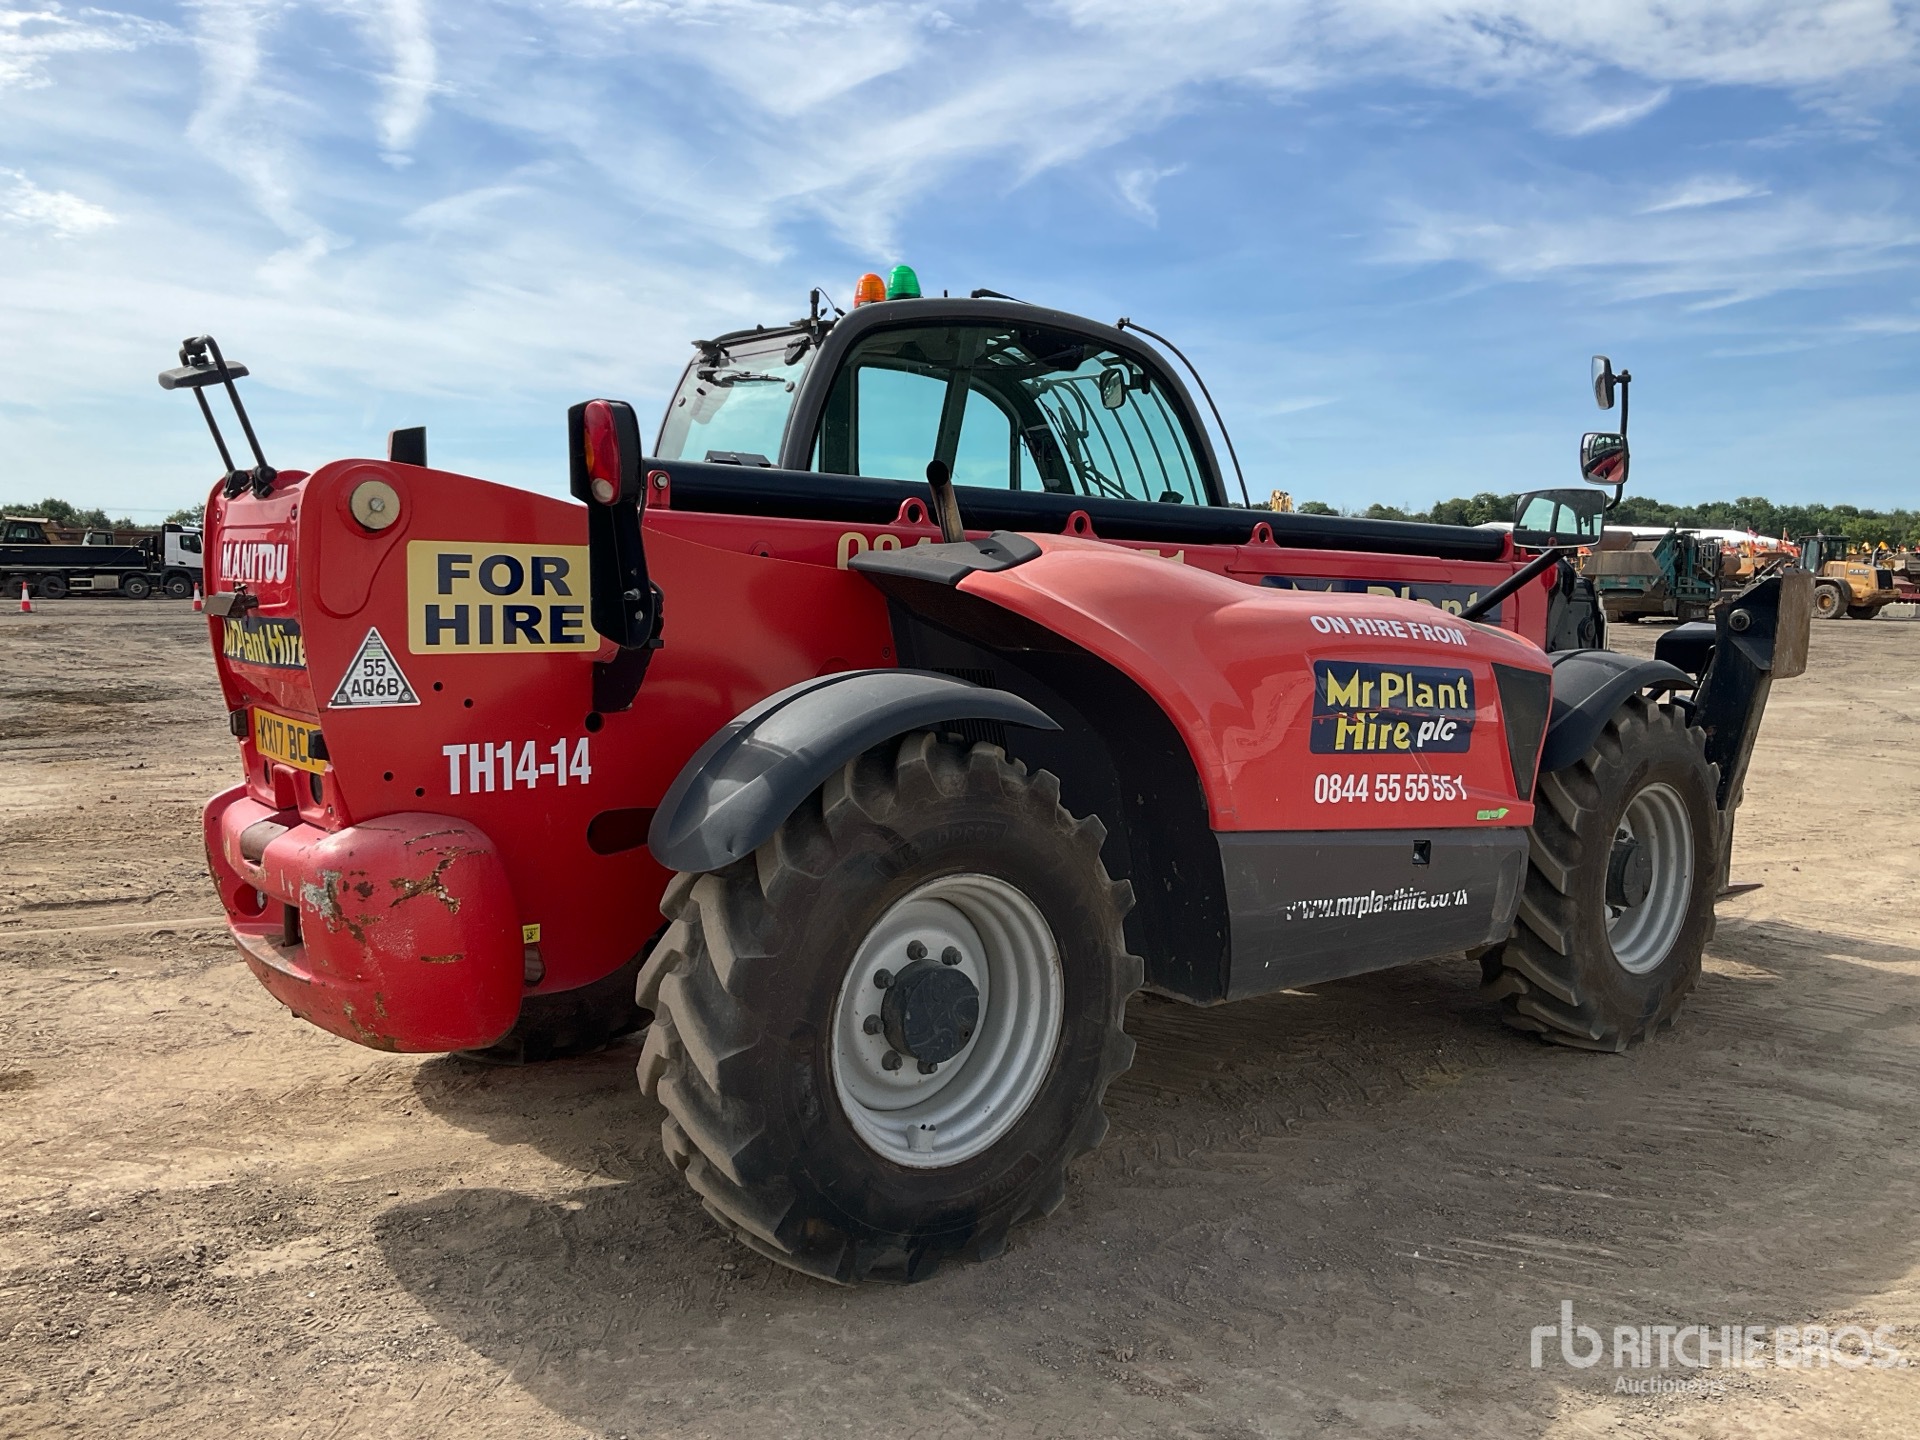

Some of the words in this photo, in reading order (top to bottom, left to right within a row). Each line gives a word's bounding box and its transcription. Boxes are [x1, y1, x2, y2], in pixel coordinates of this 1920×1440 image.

[220, 541, 289, 584] MANITOU
[436, 553, 573, 597] FOR
[230, 619, 270, 664] Plant
[265, 623, 307, 667] Hire
[424, 604, 586, 646] HIRE
[1309, 615, 1350, 634] ON
[1348, 617, 1408, 639] HIRE
[1405, 622, 1468, 646] FROM
[350, 677, 400, 698] AQ6B
[363, 658, 387, 677] 55
[1327, 667, 1375, 709] Mr
[1380, 671, 1469, 710] Plant
[259, 714, 284, 756] KX17
[287, 723, 317, 766] BC
[1334, 711, 1411, 751] Hire
[1416, 714, 1458, 748] plc
[442, 737, 593, 795] TH14-14
[1314, 773, 1369, 804] 0844
[1374, 773, 1401, 803] 55
